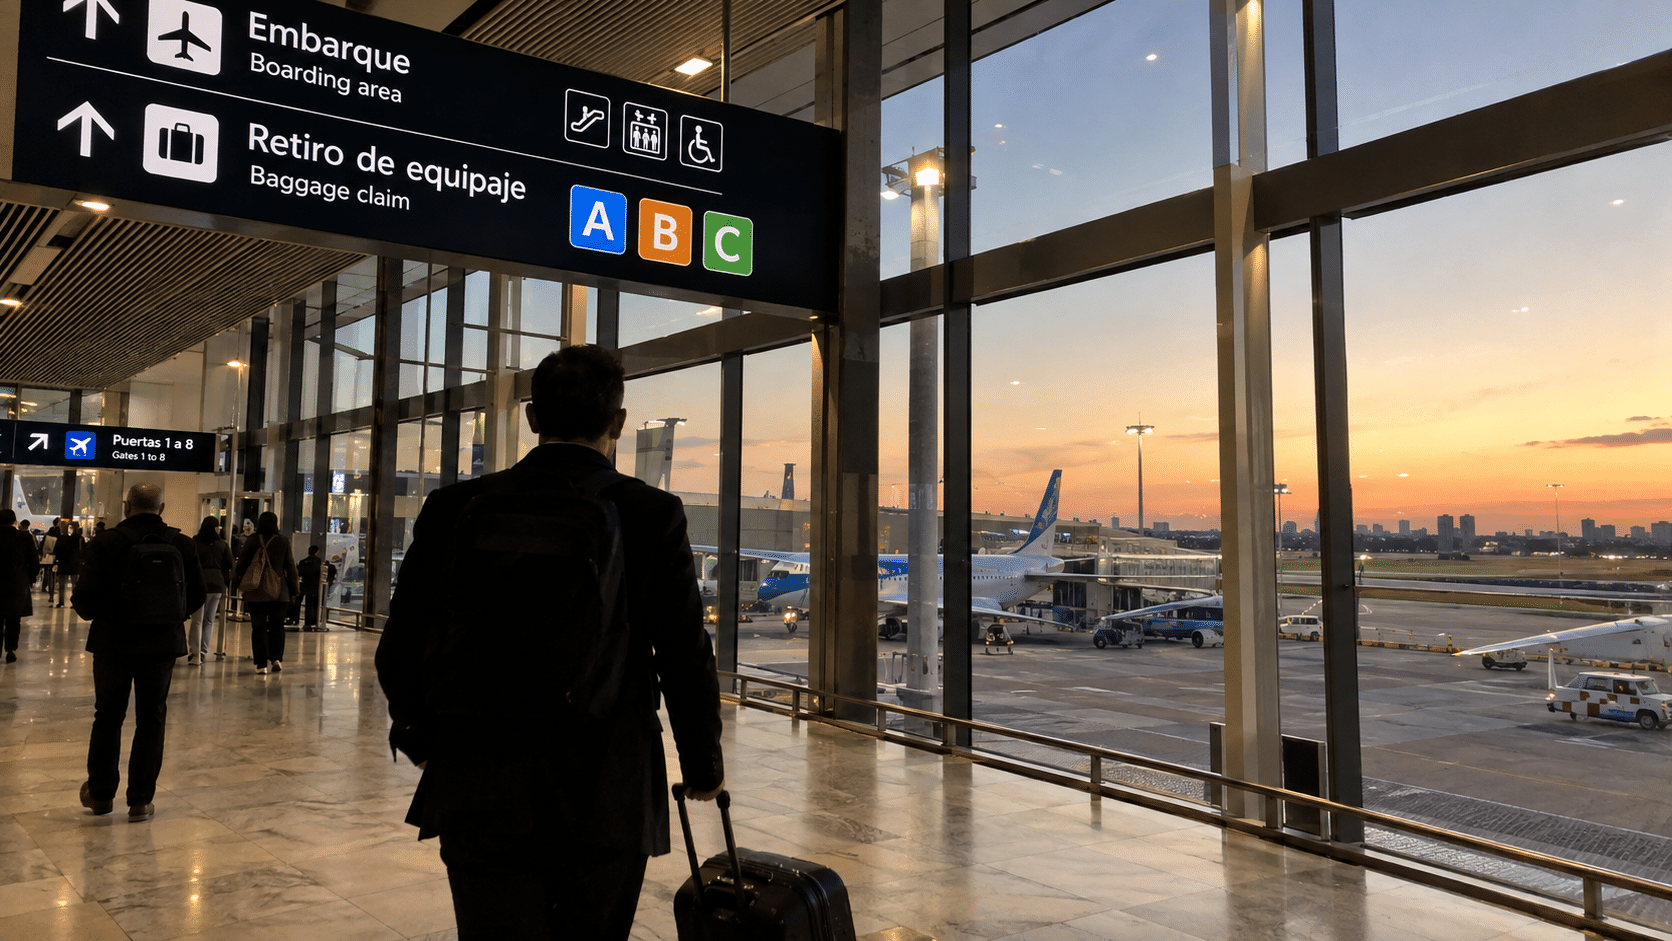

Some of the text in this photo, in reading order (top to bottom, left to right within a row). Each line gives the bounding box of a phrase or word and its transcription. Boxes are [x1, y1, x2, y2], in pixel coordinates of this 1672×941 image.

[248, 10, 411, 74] Embarque
[250, 52, 402, 103] Boarding area
[248, 122, 526, 204] Retiro de equipaje
[250, 164, 410, 211] Baggage claim
[581, 200, 741, 263] A B C
[112, 450, 166, 461] Gates 1 to 8
[113, 434, 194, 449] Puertas 1 a 8
